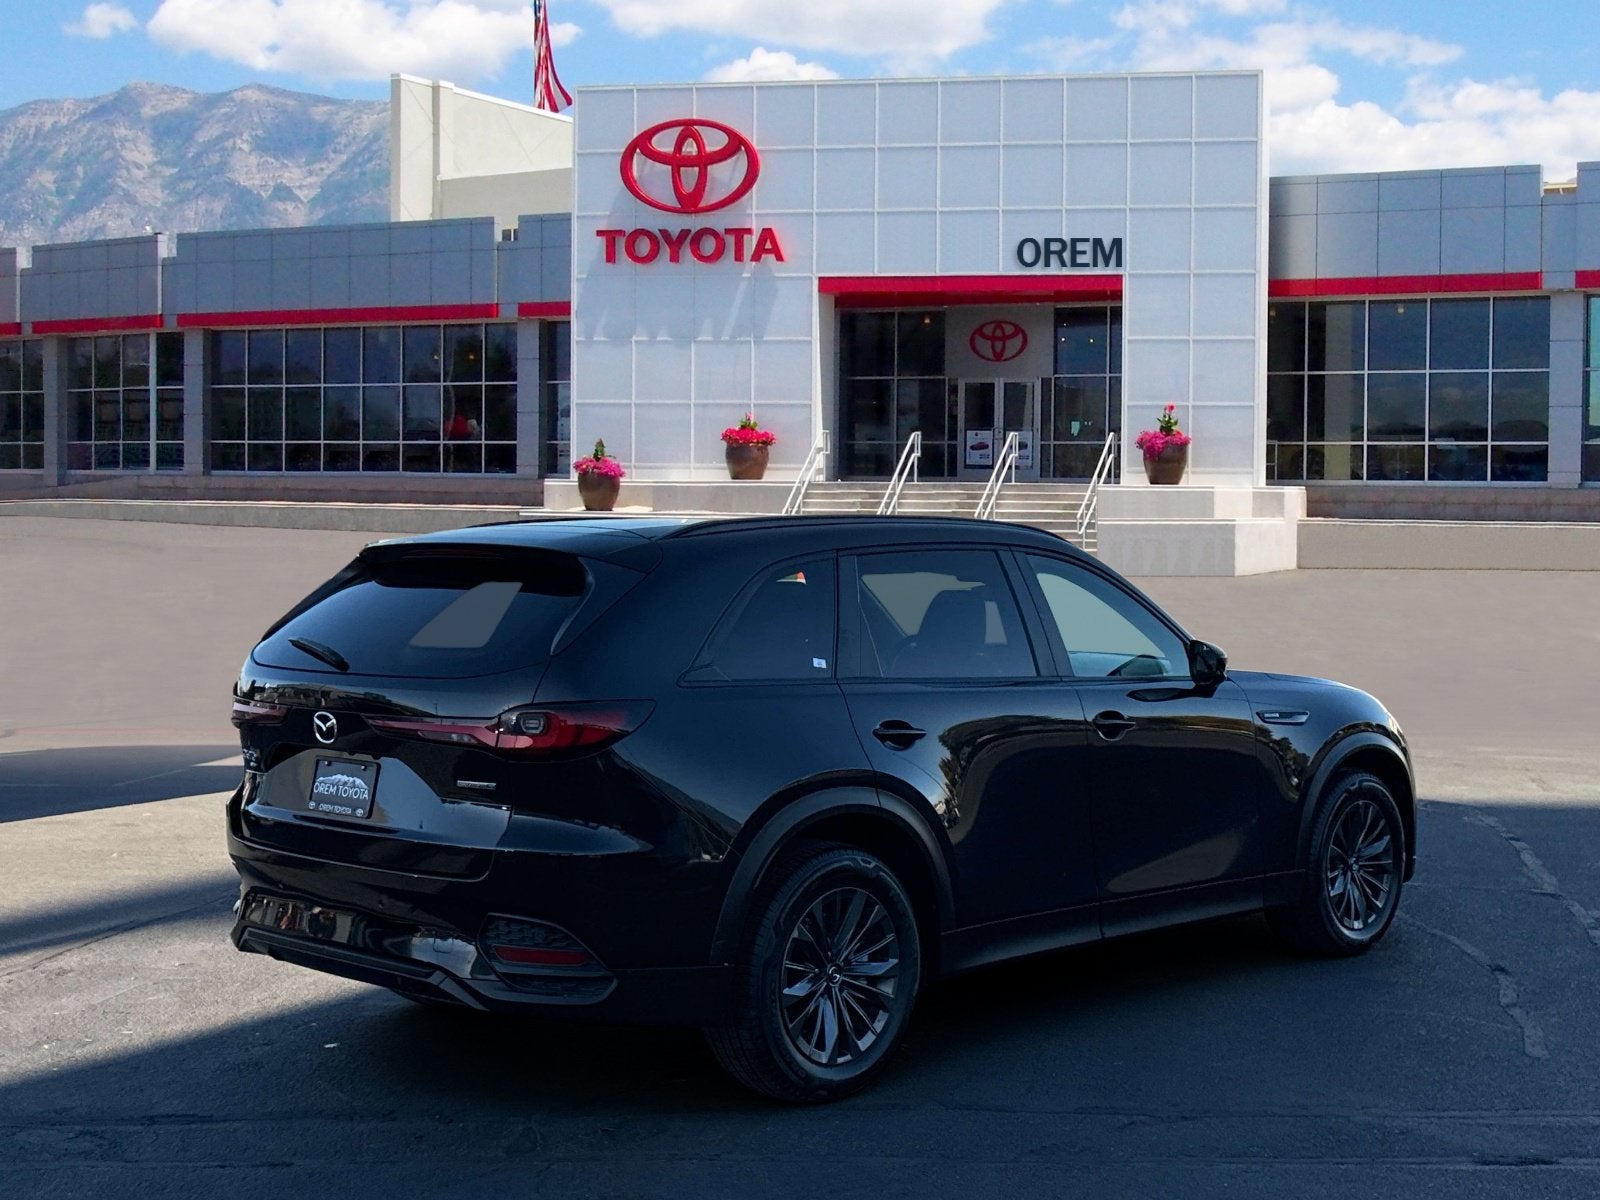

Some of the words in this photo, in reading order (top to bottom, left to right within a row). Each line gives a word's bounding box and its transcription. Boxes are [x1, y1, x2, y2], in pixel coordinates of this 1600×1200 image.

[596, 227, 785, 264] TOYOTA
[1017, 237, 1123, 268] OREM
[314, 782, 337, 795] OREM
[338, 785, 369, 801] TOYOTA
